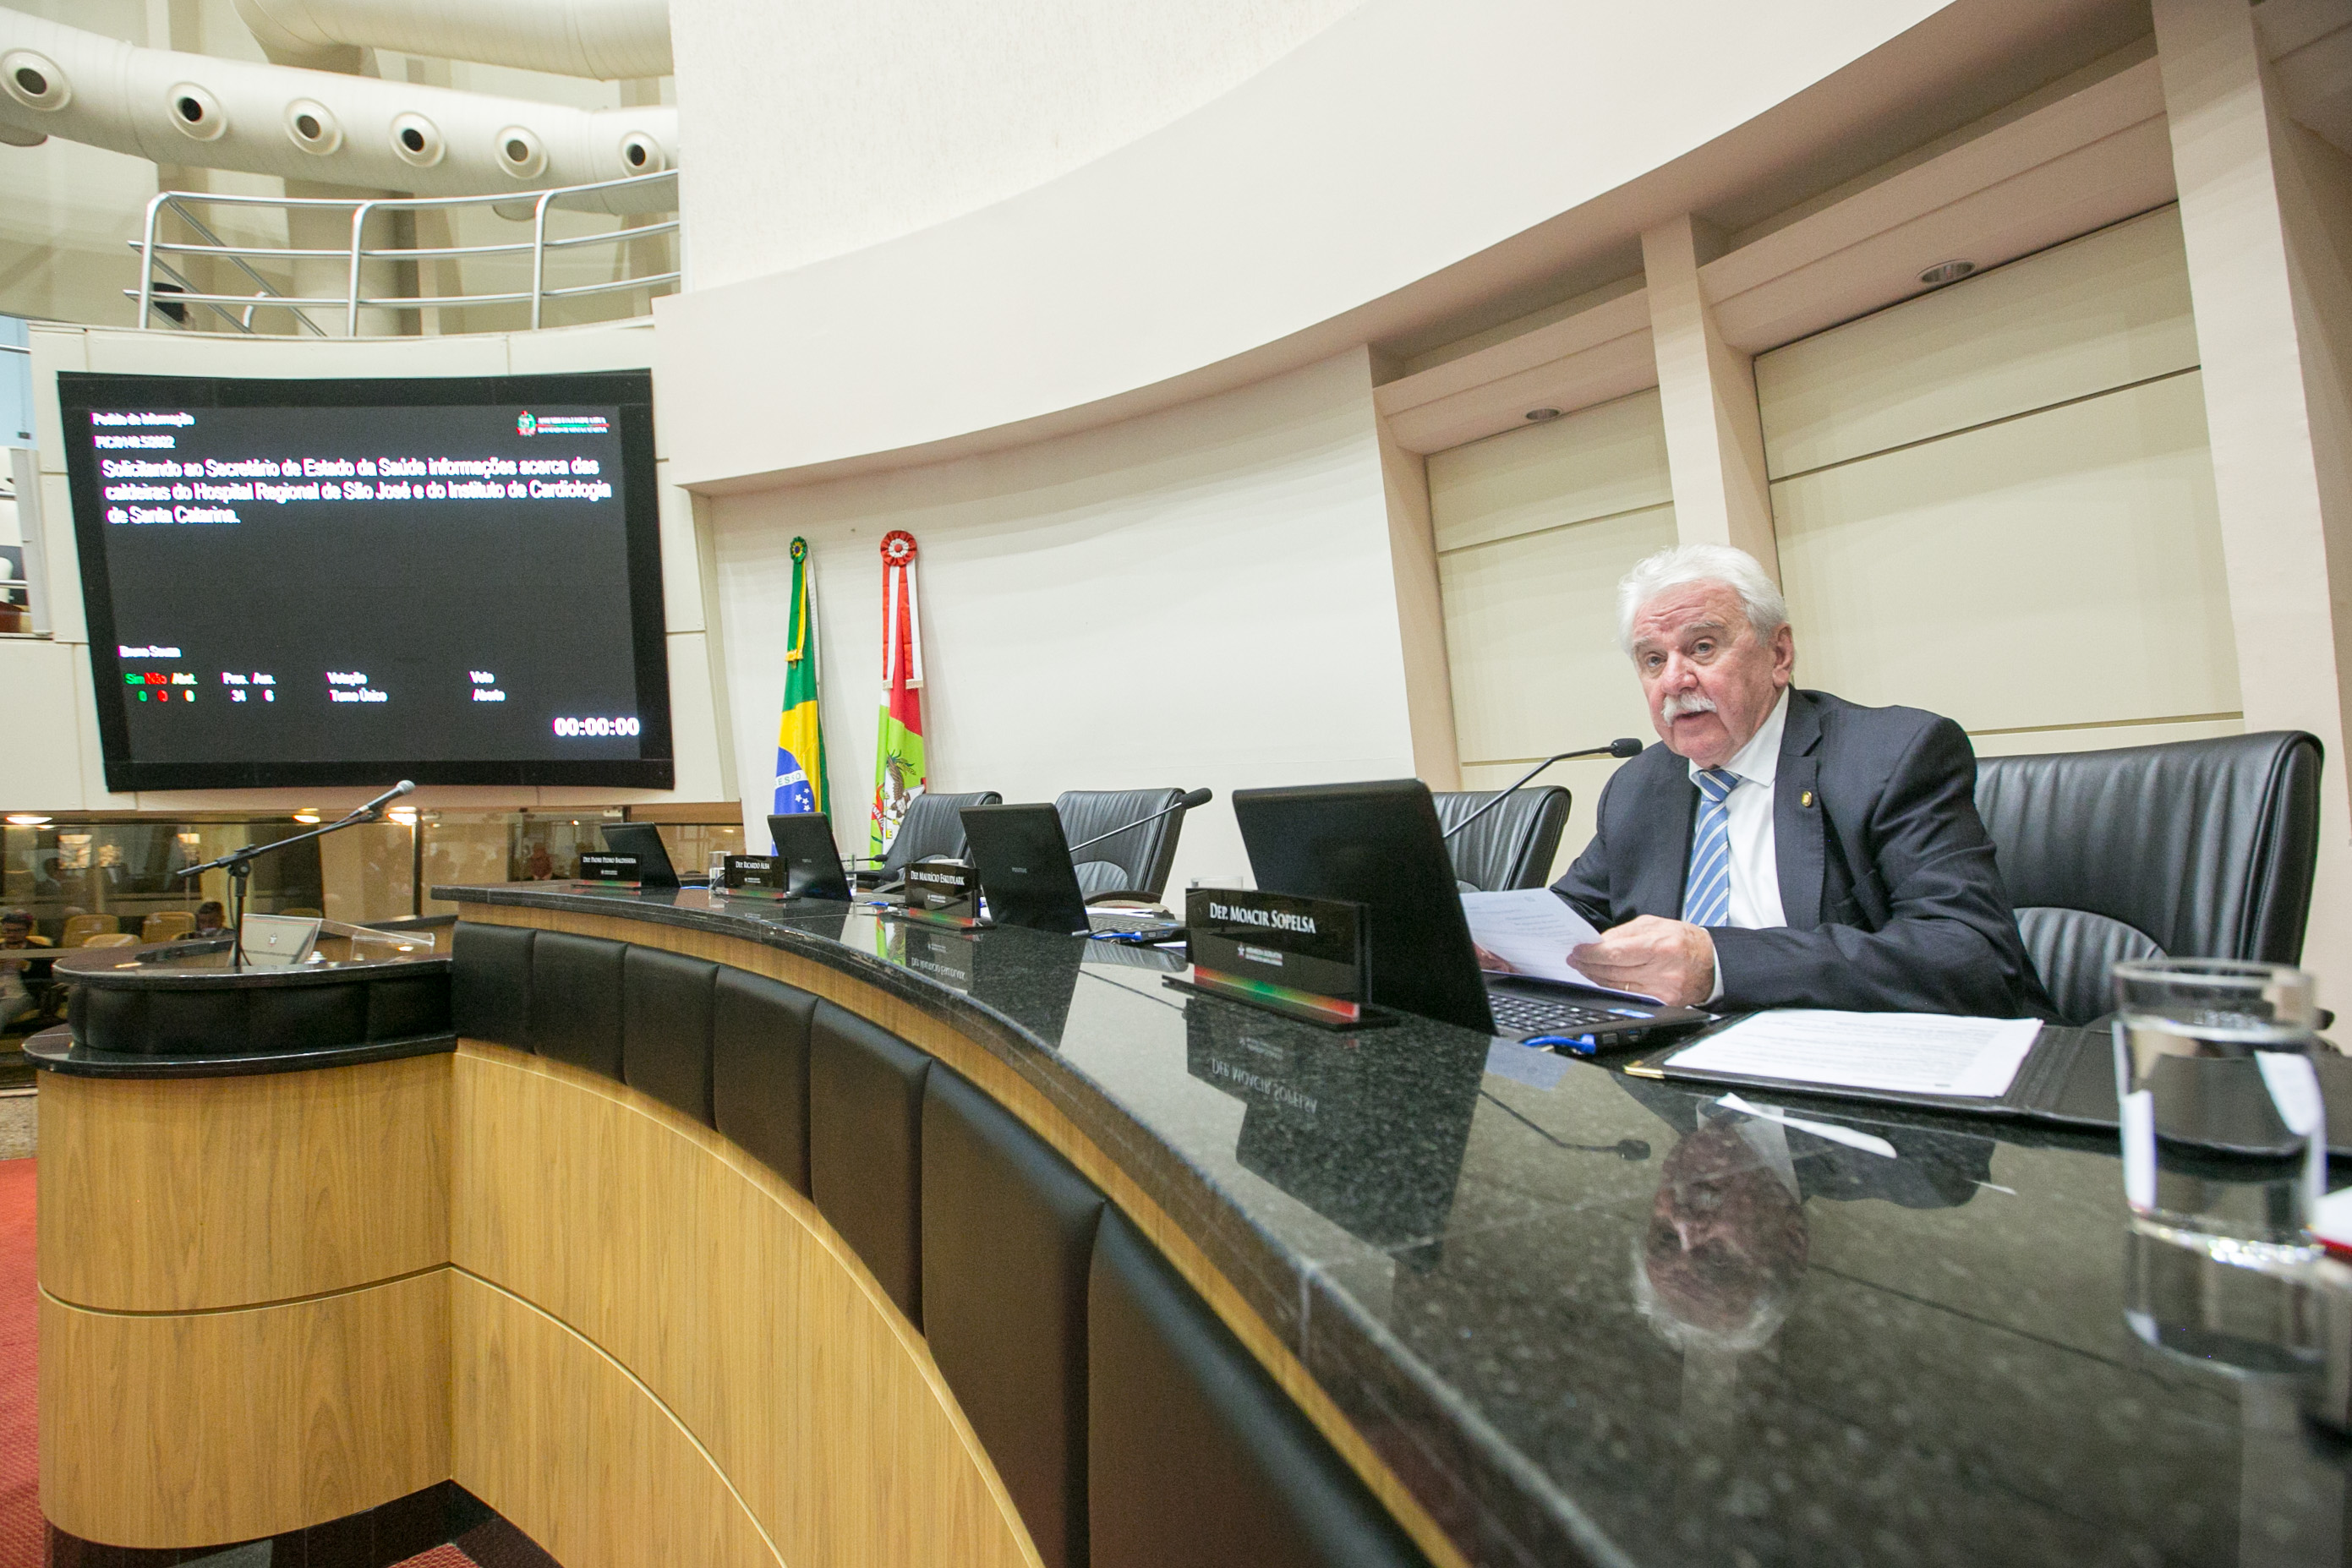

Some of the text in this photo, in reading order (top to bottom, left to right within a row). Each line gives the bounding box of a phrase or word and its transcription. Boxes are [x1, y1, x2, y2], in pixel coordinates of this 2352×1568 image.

[101, 456, 600, 479] Solicitando ao Secretário de Estado da Saúde informações acerca das
[103, 479, 612, 504] caldeiras do Hospital Regional de São José e do Instituto de Cardiologia
[106, 505, 241, 524] de Santa Catarina.
[124, 673, 145, 684] Sim
[145, 672, 167, 685] Não
[325, 672, 368, 686] Votação
[468, 671, 495, 684] Voto
[552, 717, 640, 737] 00:00:00
[774, 773, 801, 786] ESSO
[1210, 902, 1316, 934] DEP. MOACIR SOPELSA
